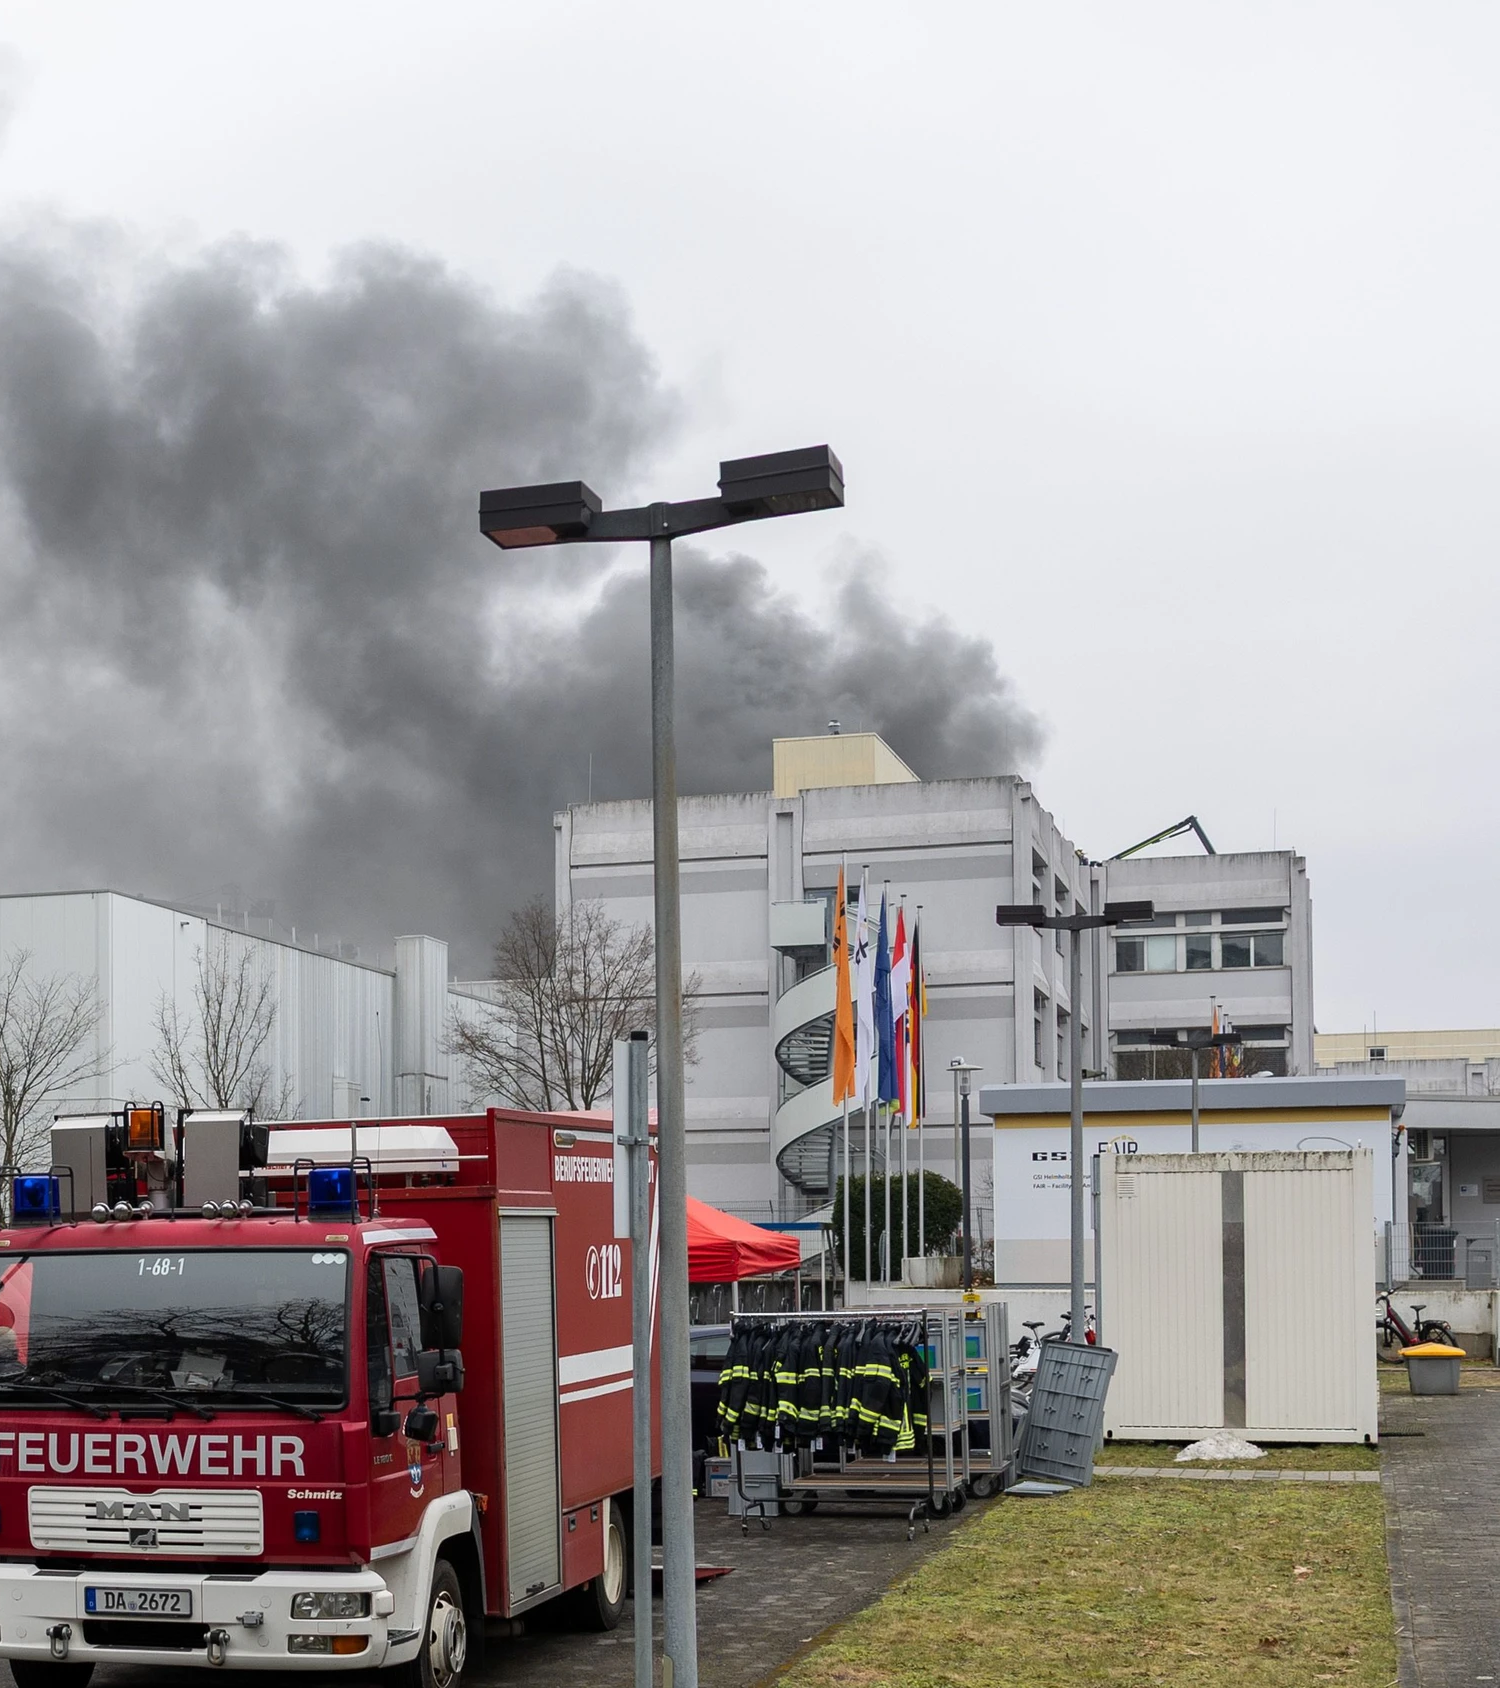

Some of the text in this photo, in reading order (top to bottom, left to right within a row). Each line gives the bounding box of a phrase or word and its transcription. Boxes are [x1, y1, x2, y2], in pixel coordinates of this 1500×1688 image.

[1032, 1152, 1072, 1161] GS
[138, 1257, 185, 1276] 1-68-1
[599, 1244, 623, 1299] 112
[287, 1488, 343, 1501] Schmitz
[95, 1501, 191, 1521] MAN
[104, 1591, 127, 1610] DA
[138, 1592, 181, 1612] 2672
